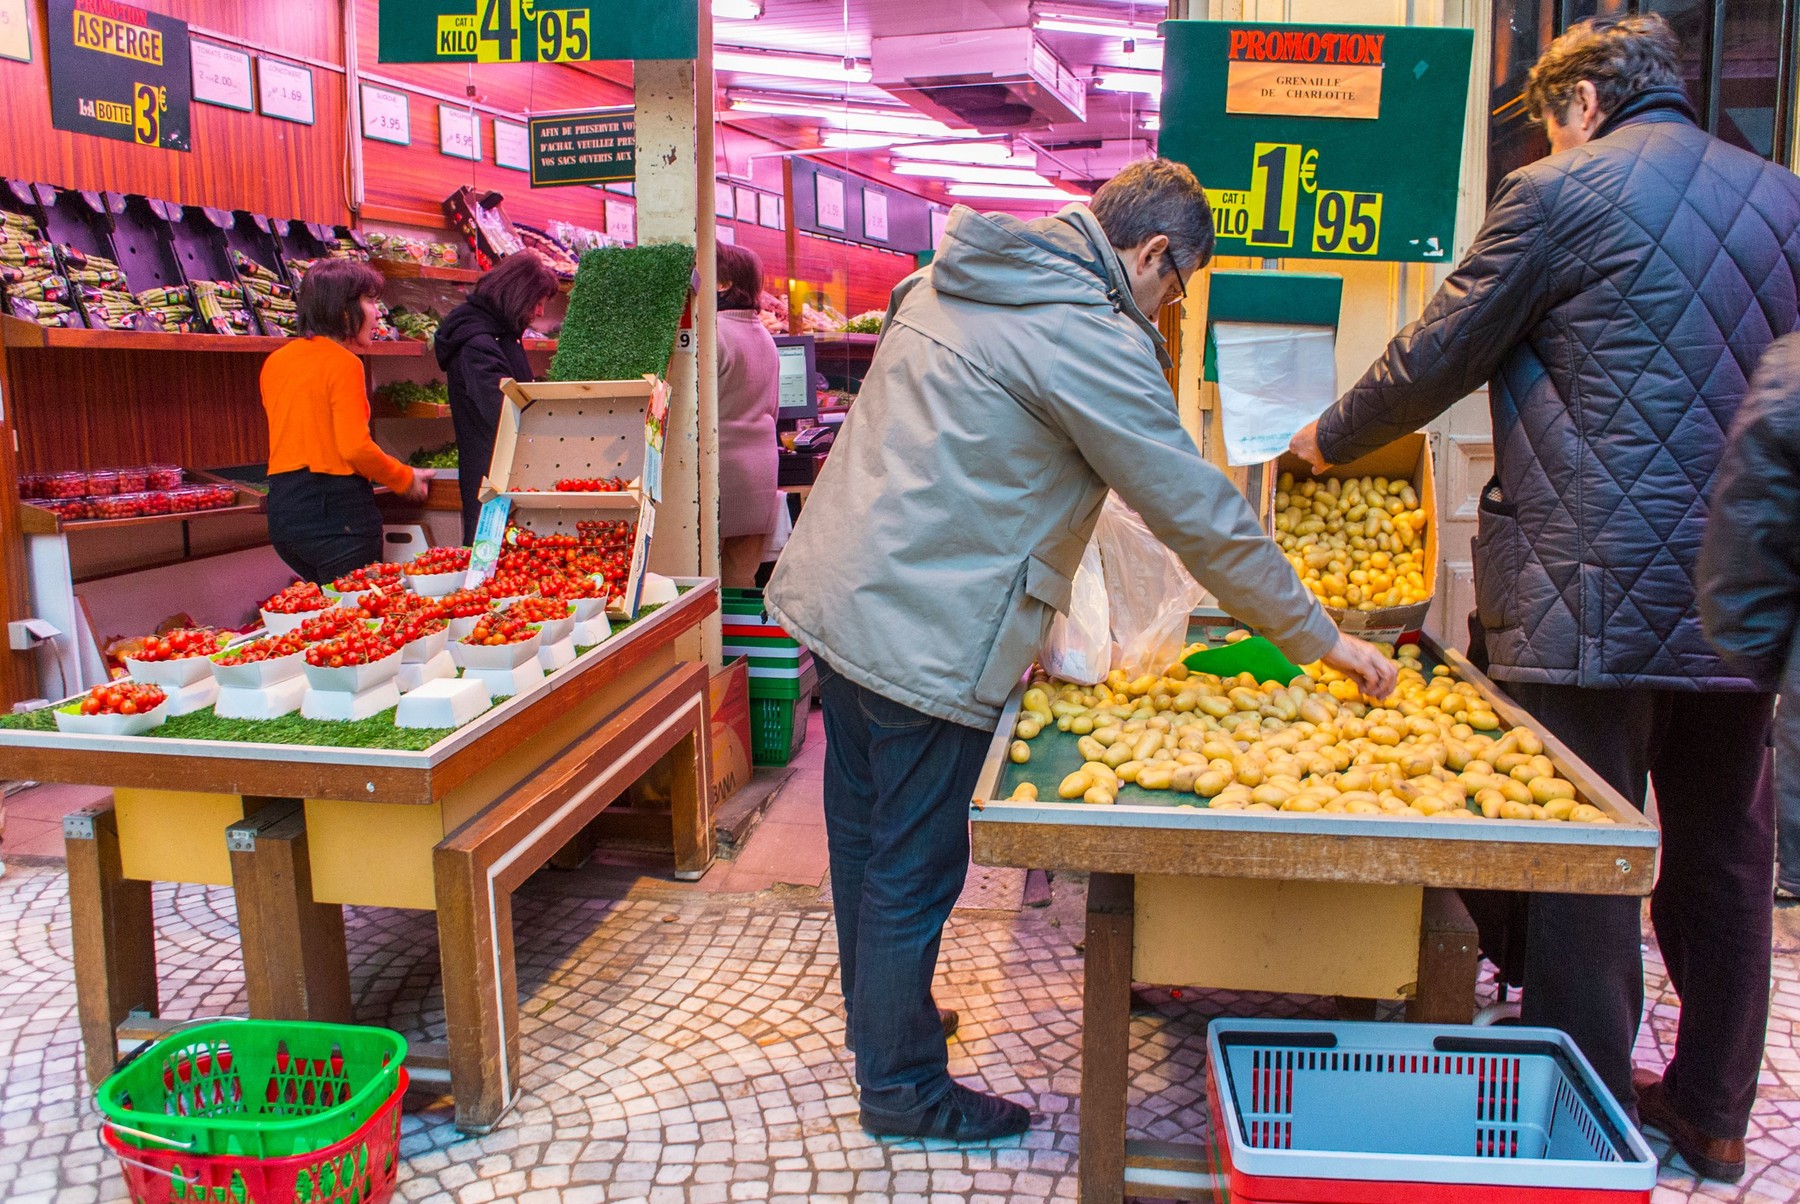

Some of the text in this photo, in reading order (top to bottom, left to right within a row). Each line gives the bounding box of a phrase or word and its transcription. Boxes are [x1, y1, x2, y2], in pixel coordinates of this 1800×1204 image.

[455, 17, 467, 27] CAT
[78, 14, 161, 62] ASPERGE
[441, 30, 477, 53] KILO
[1228, 30, 1385, 64] PROMOTION
[1276, 75, 1342, 87] GRENAILLE
[1261, 88, 1355, 101] DE CHARLOTTE
[79, 98, 96, 117] LA
[98, 103, 131, 123] BOTTE
[381, 115, 400, 130] 3.95
[541, 127, 559, 137] AFIN
[562, 126, 573, 136] DE
[575, 122, 620, 135] PRESERVER
[577, 138, 615, 149] VEUILLEZ
[541, 151, 632, 167] VOS SACS OUVERTS AUX
[1222, 192, 1239, 205] CAT
[1212, 207, 1249, 236] ILO
